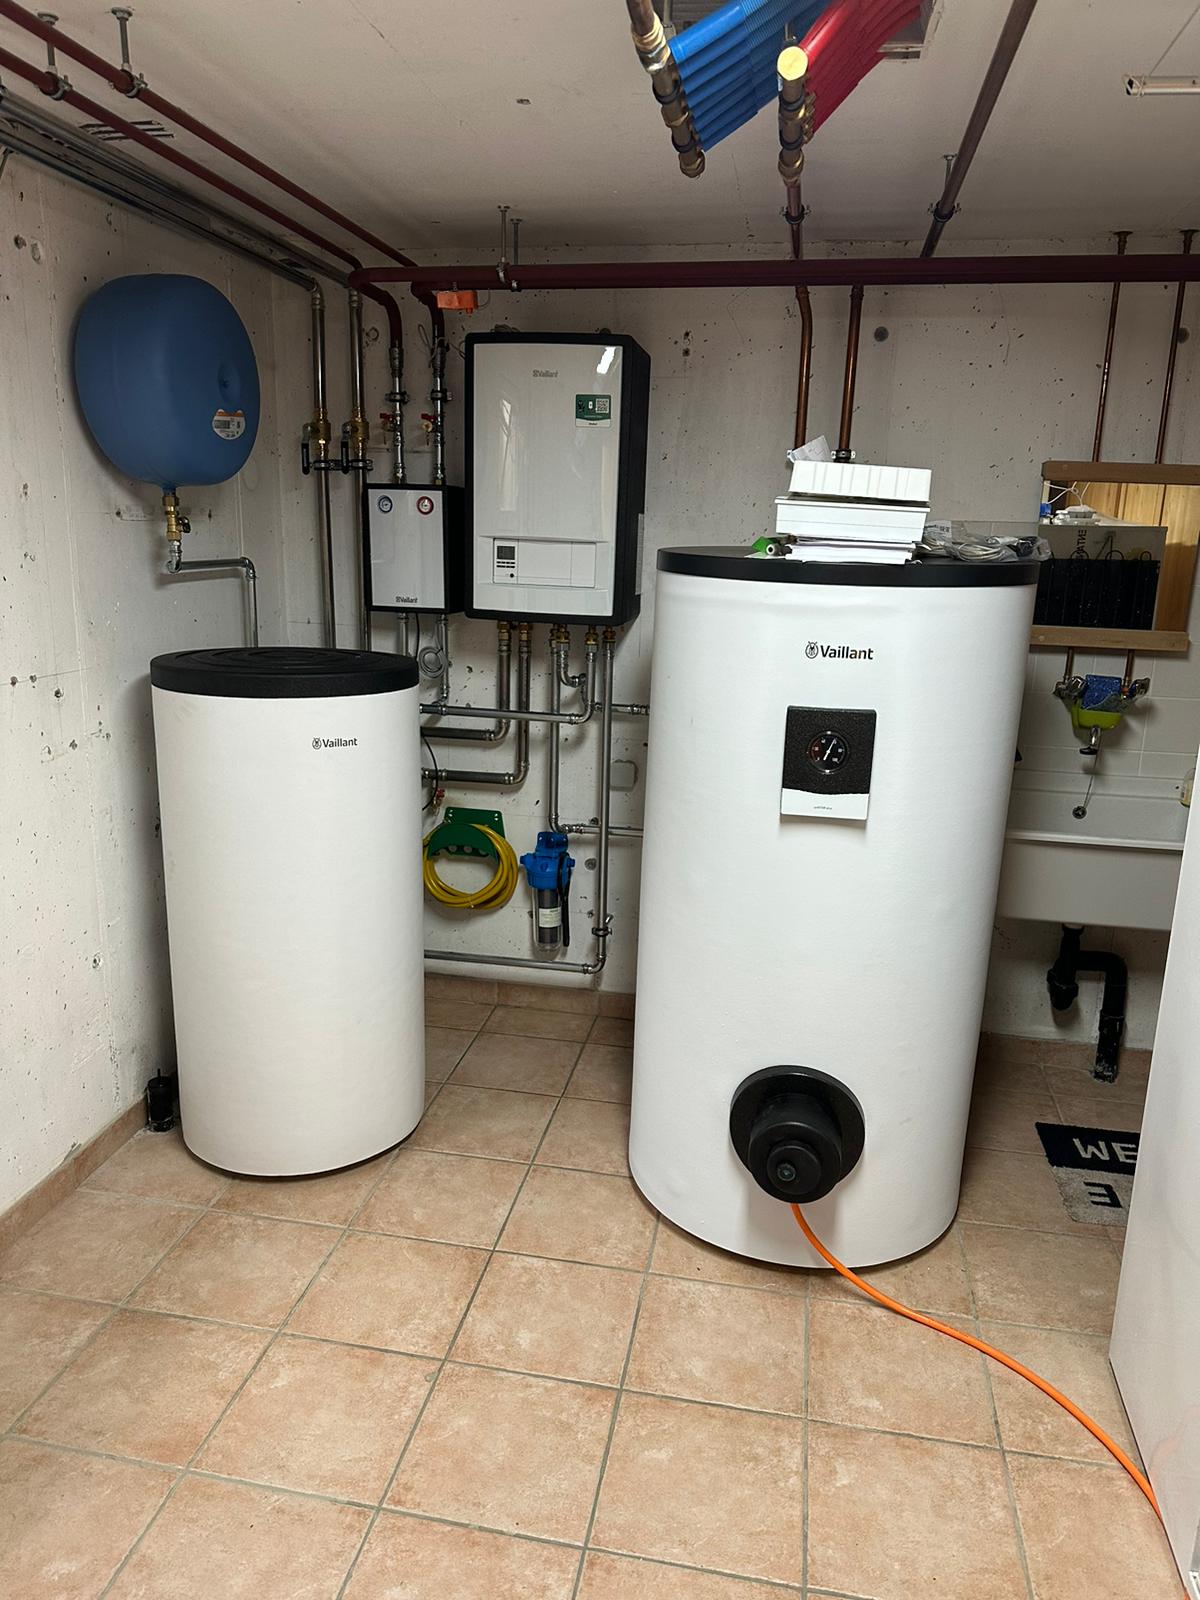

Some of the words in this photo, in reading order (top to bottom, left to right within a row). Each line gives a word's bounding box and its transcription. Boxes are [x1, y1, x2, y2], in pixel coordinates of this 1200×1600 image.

[820, 645, 874, 660] Vaillant
[322, 737, 358, 748] Vaillant
[1073, 1137, 1138, 1163] WE
